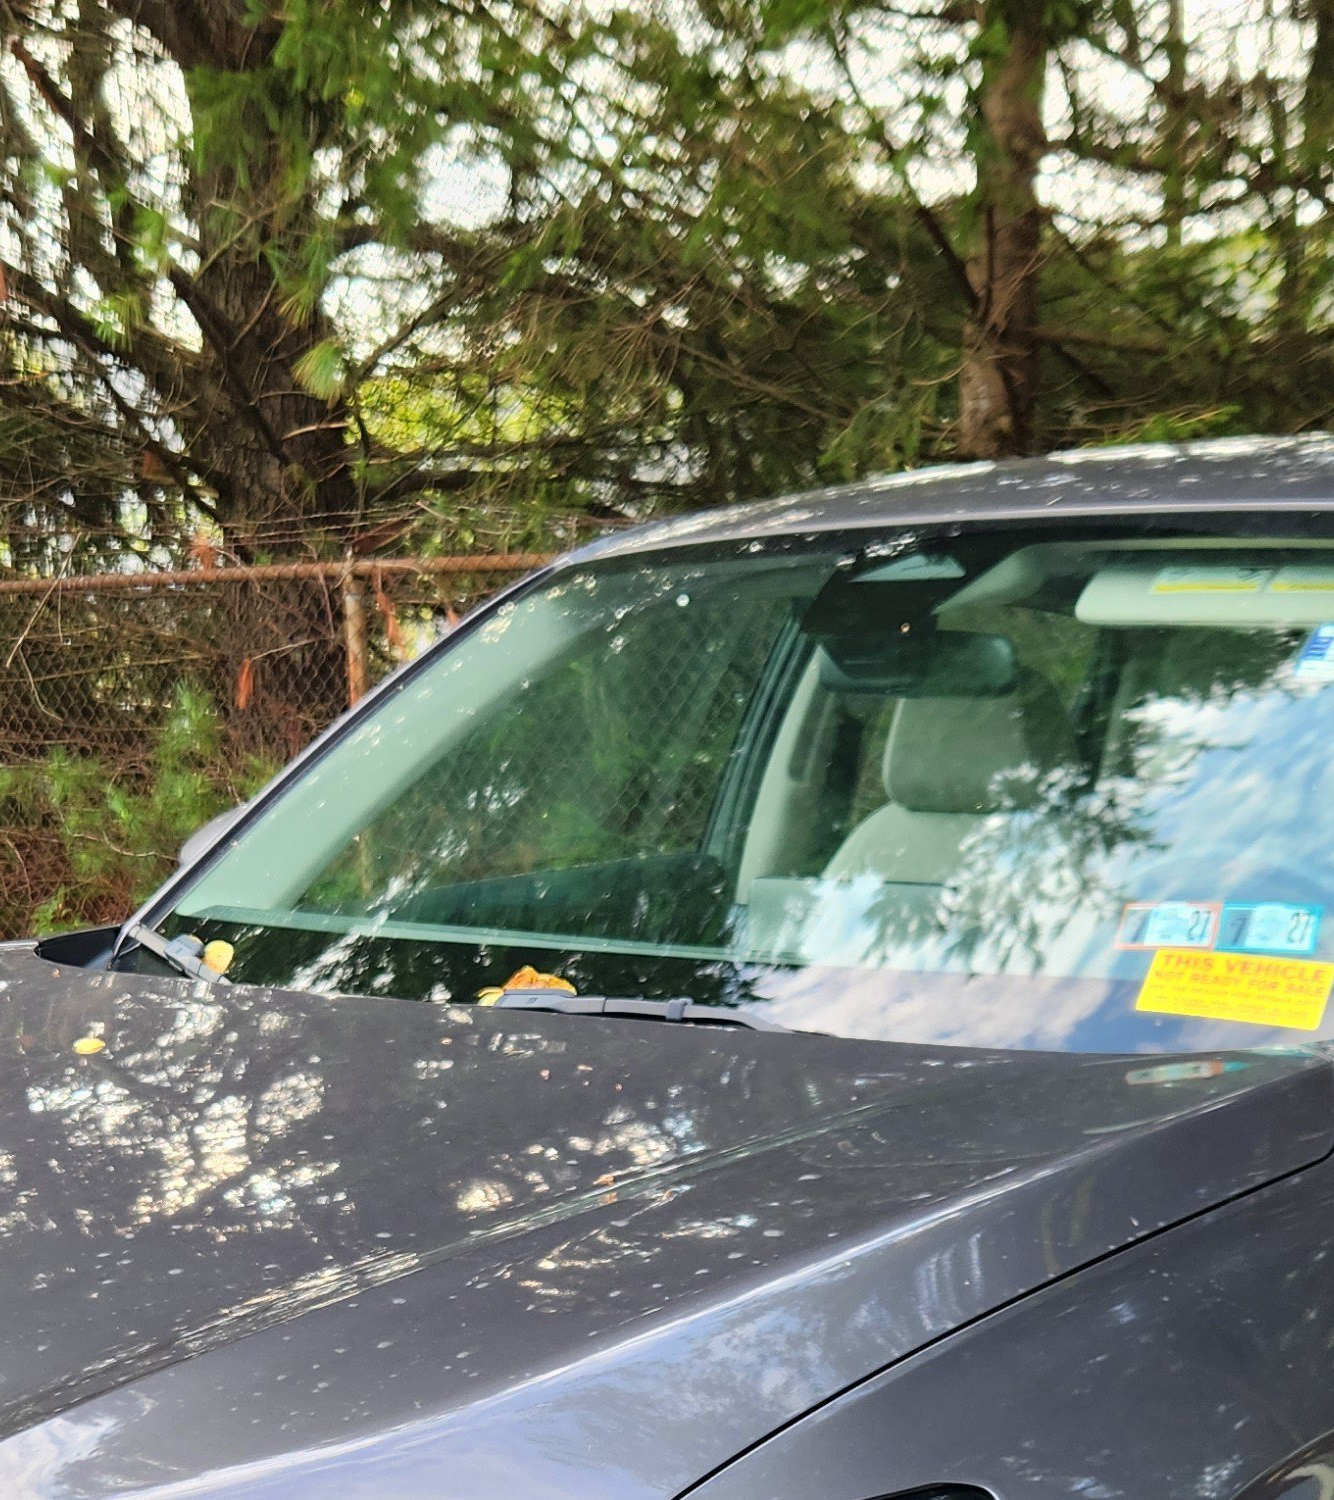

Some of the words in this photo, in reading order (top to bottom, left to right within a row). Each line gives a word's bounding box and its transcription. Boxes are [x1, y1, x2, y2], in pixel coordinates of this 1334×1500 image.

[1163, 954, 1215, 971] THIS
[1225, 959, 1326, 983] VEHICLE
[1189, 973, 1242, 988] READY
[1247, 979, 1279, 991] FOR
[1284, 983, 1325, 997] SALE
